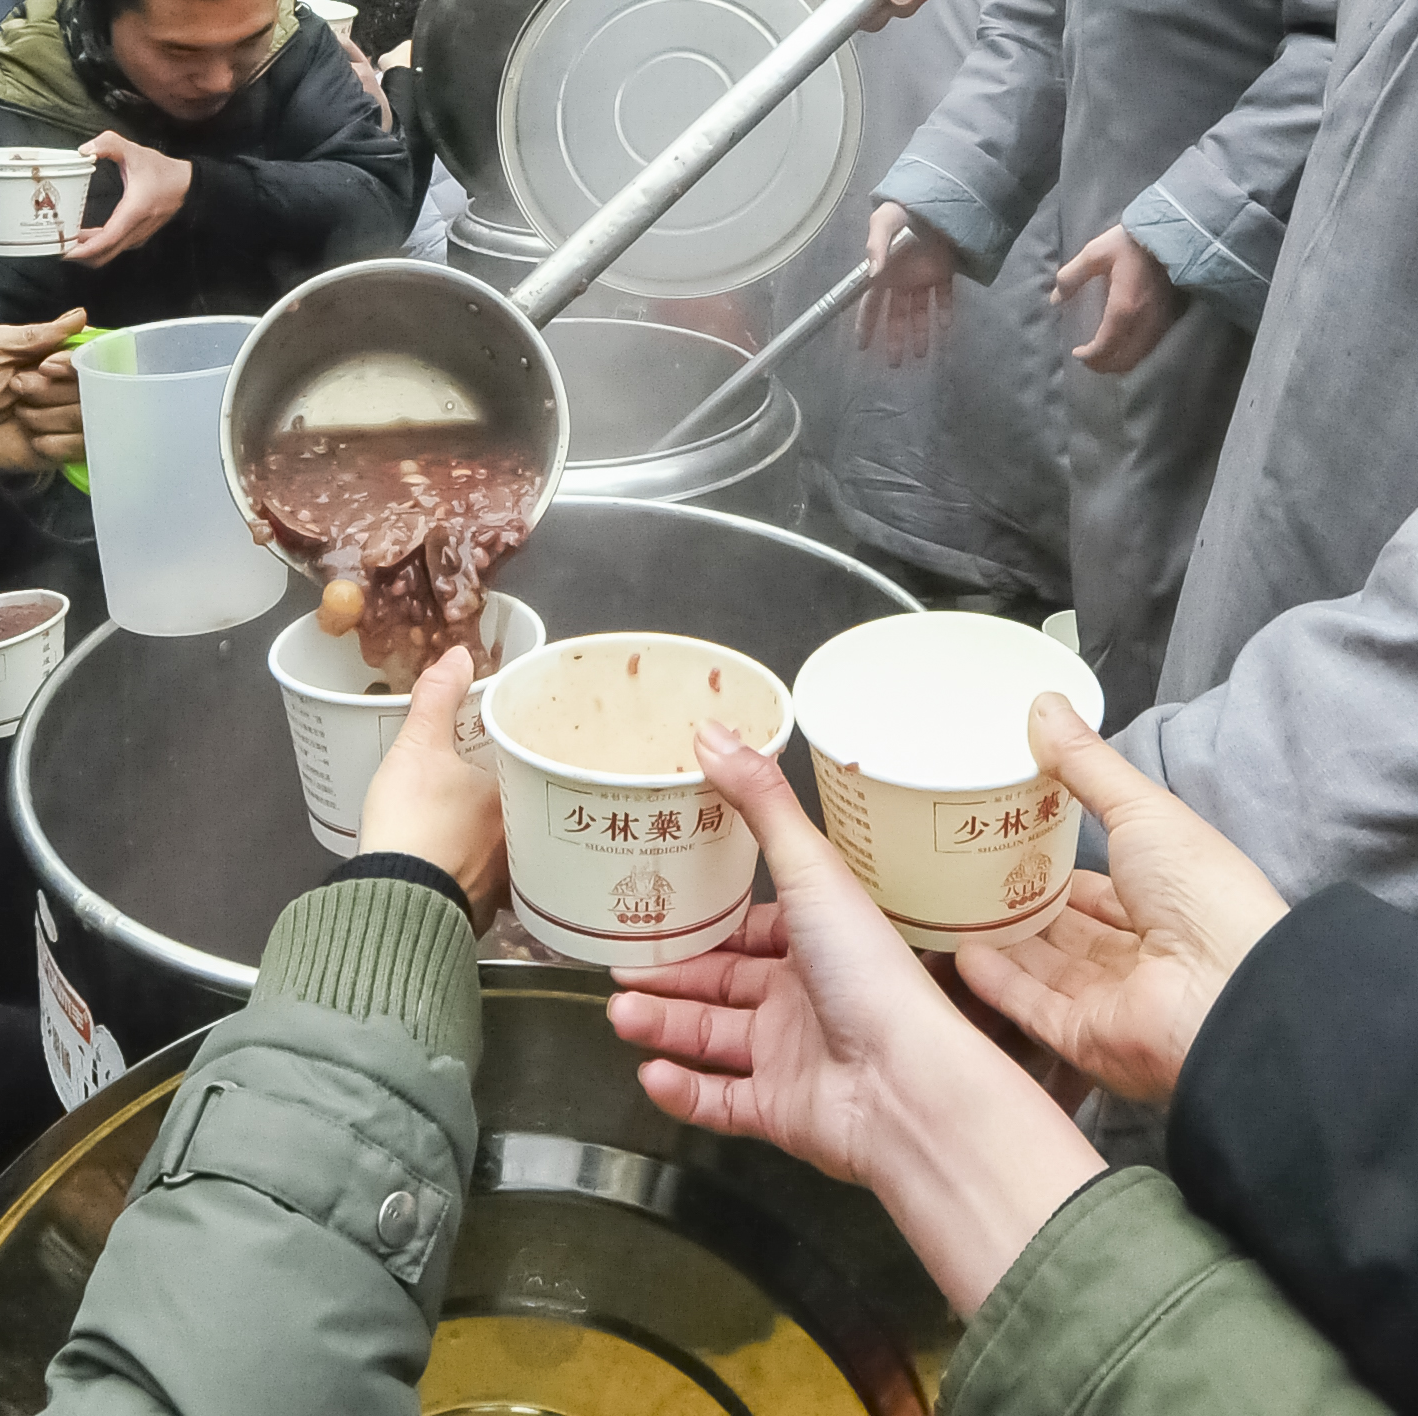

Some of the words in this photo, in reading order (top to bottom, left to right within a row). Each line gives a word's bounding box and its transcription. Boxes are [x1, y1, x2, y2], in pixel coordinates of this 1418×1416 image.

[564, 803, 725, 844] 少林藥局
[953, 789, 1061, 846] 少林藥
[584, 841, 634, 856] SHAOLIN
[638, 841, 696, 856] MEDICINE
[977, 838, 1024, 854] SHAOLIN
